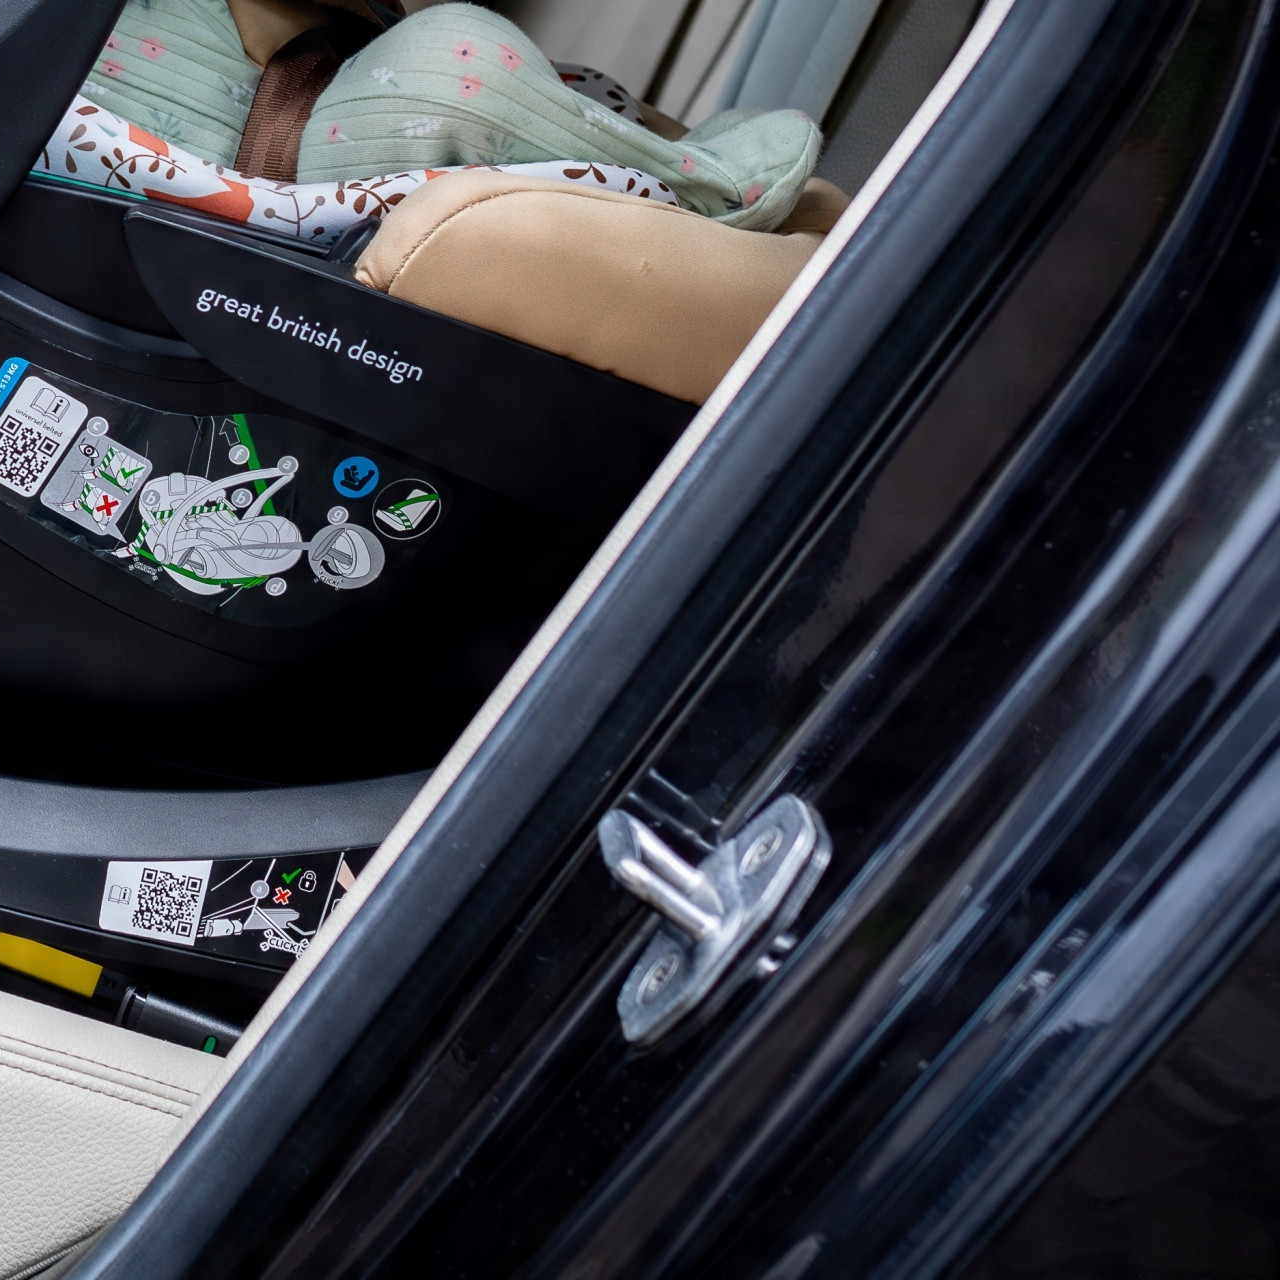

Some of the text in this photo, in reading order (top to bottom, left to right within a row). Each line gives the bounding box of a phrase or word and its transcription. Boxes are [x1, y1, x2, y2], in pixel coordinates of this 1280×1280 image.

[196, 289, 422, 383] great british design
[7, 363, 19, 375] KG
[15, 408, 63, 437] universal belted
[236, 491, 246, 504] b
[332, 510, 343, 522] g
[270, 581, 282, 593] d
[270, 938, 300, 952] CLICK!
